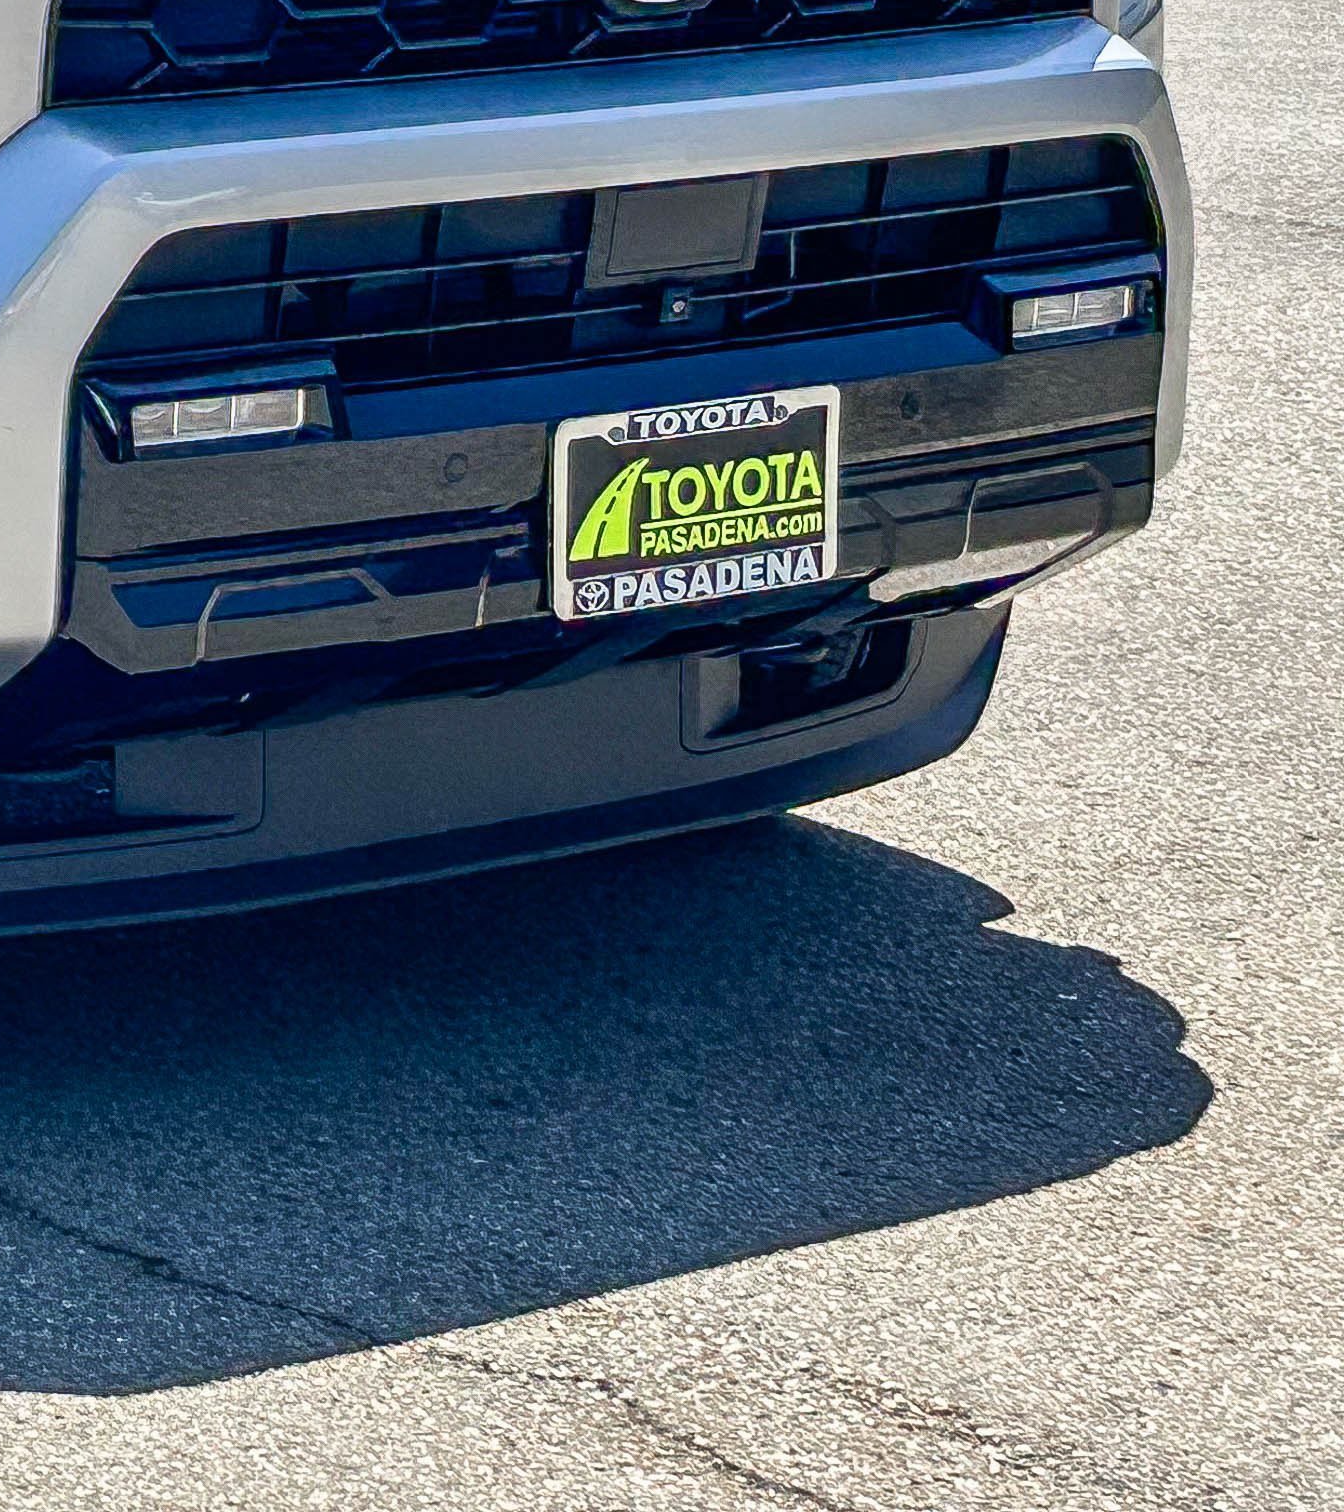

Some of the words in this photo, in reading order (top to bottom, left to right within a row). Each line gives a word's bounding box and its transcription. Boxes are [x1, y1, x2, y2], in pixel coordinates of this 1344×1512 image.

[634, 399, 769, 438] TOYOTA
[642, 450, 823, 520] TOYOTA
[640, 511, 823, 558] PASADENA.com
[614, 546, 819, 610] PASADENA
